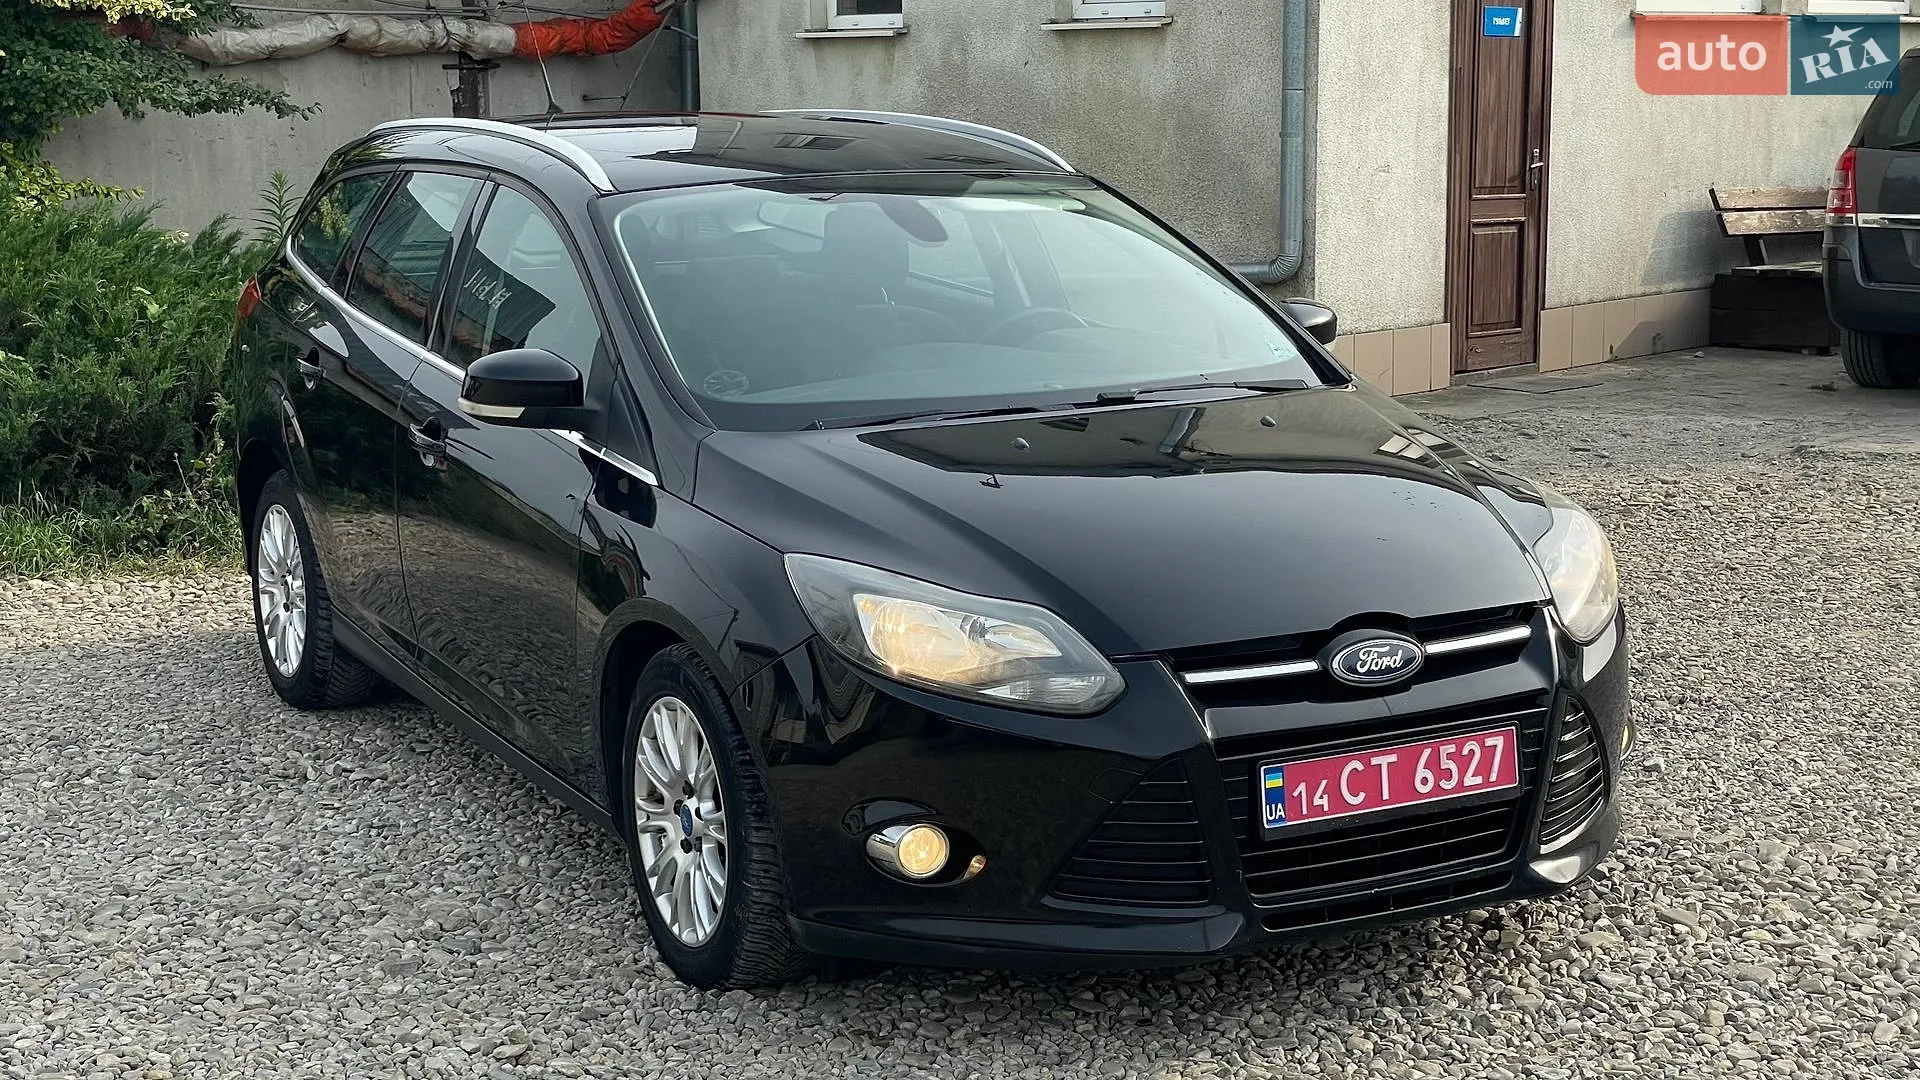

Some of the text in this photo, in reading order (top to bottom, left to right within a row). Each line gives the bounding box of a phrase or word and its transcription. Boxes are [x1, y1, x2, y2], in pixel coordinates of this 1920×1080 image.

[1356, 646, 1404, 673] Ford
[1292, 735, 1504, 815] 14 CT 6527
[1266, 803, 1285, 821] UA
